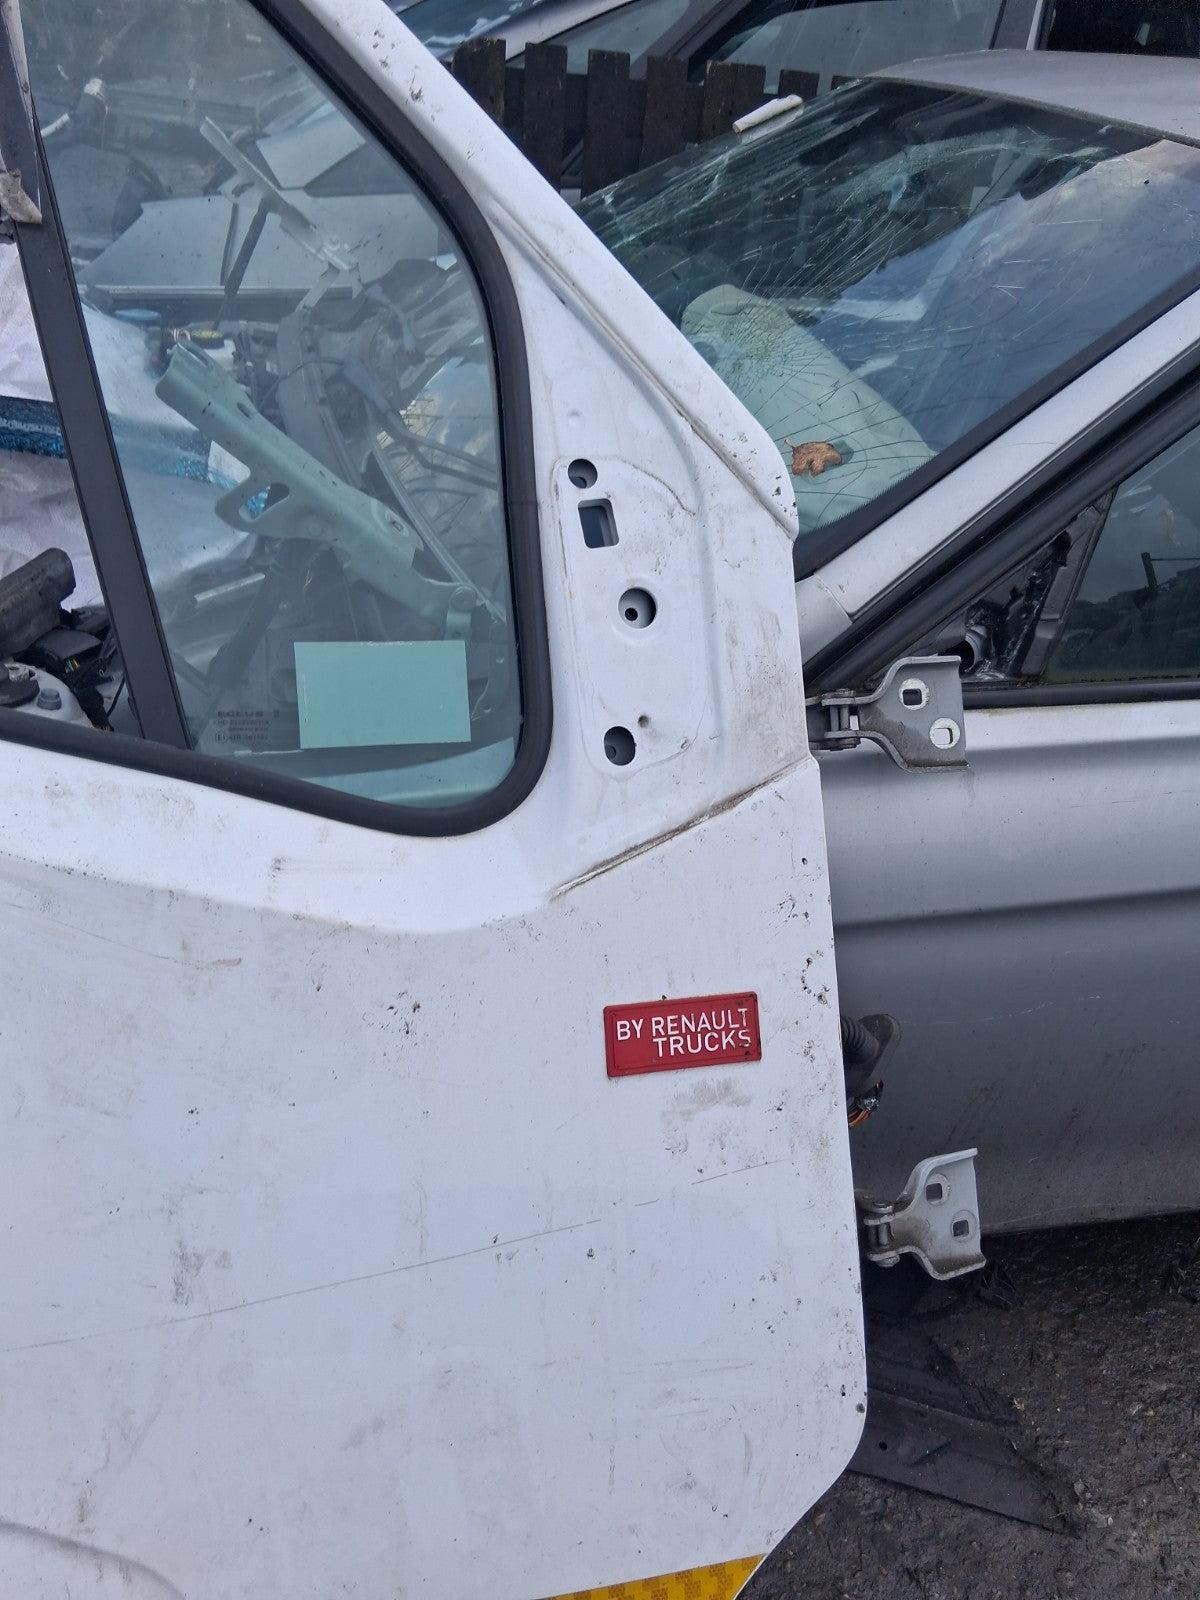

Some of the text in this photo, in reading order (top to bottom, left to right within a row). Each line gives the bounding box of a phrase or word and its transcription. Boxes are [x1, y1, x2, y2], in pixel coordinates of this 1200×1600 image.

[616, 1008, 748, 1041] BY RENAULT
[652, 1029, 752, 1058] TRUCKS
